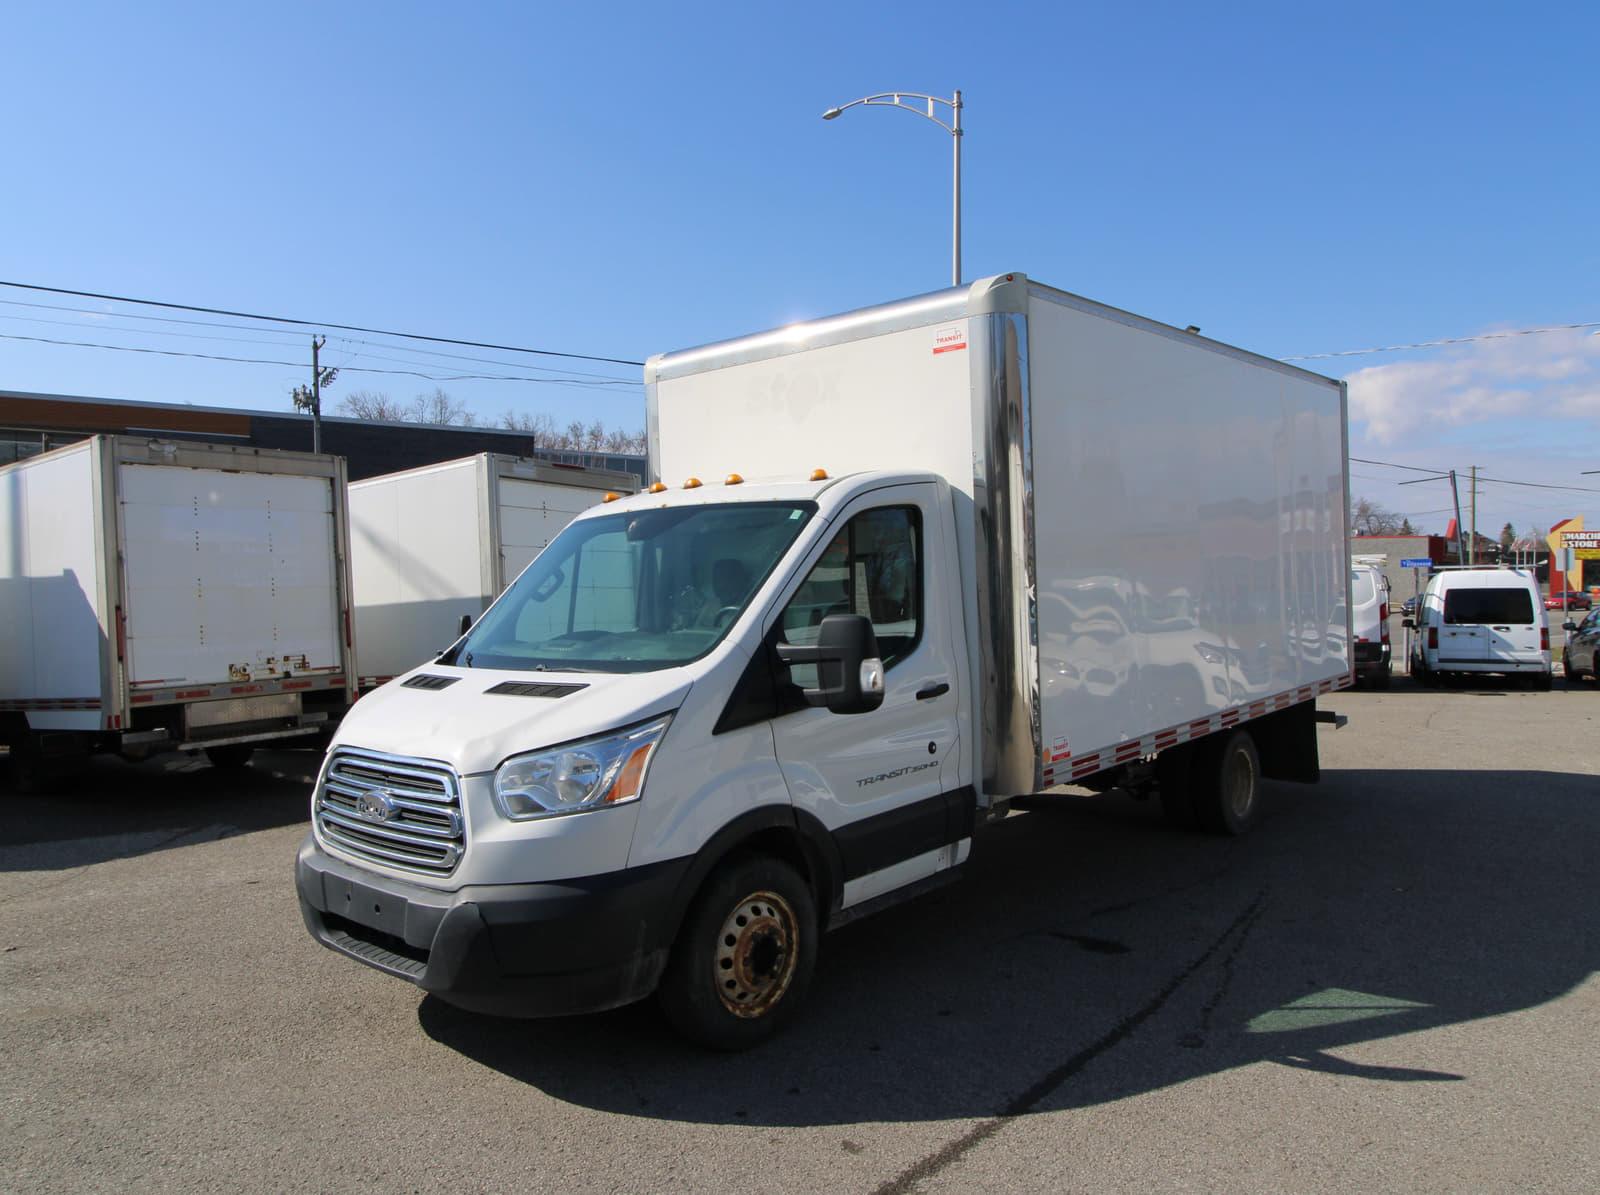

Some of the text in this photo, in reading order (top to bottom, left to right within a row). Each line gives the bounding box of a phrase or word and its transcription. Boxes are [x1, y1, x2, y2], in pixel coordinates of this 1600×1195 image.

[936, 334, 963, 344] TRANSIT
[1566, 532, 1600, 540] MARCH
[1569, 540, 1597, 548] STORE
